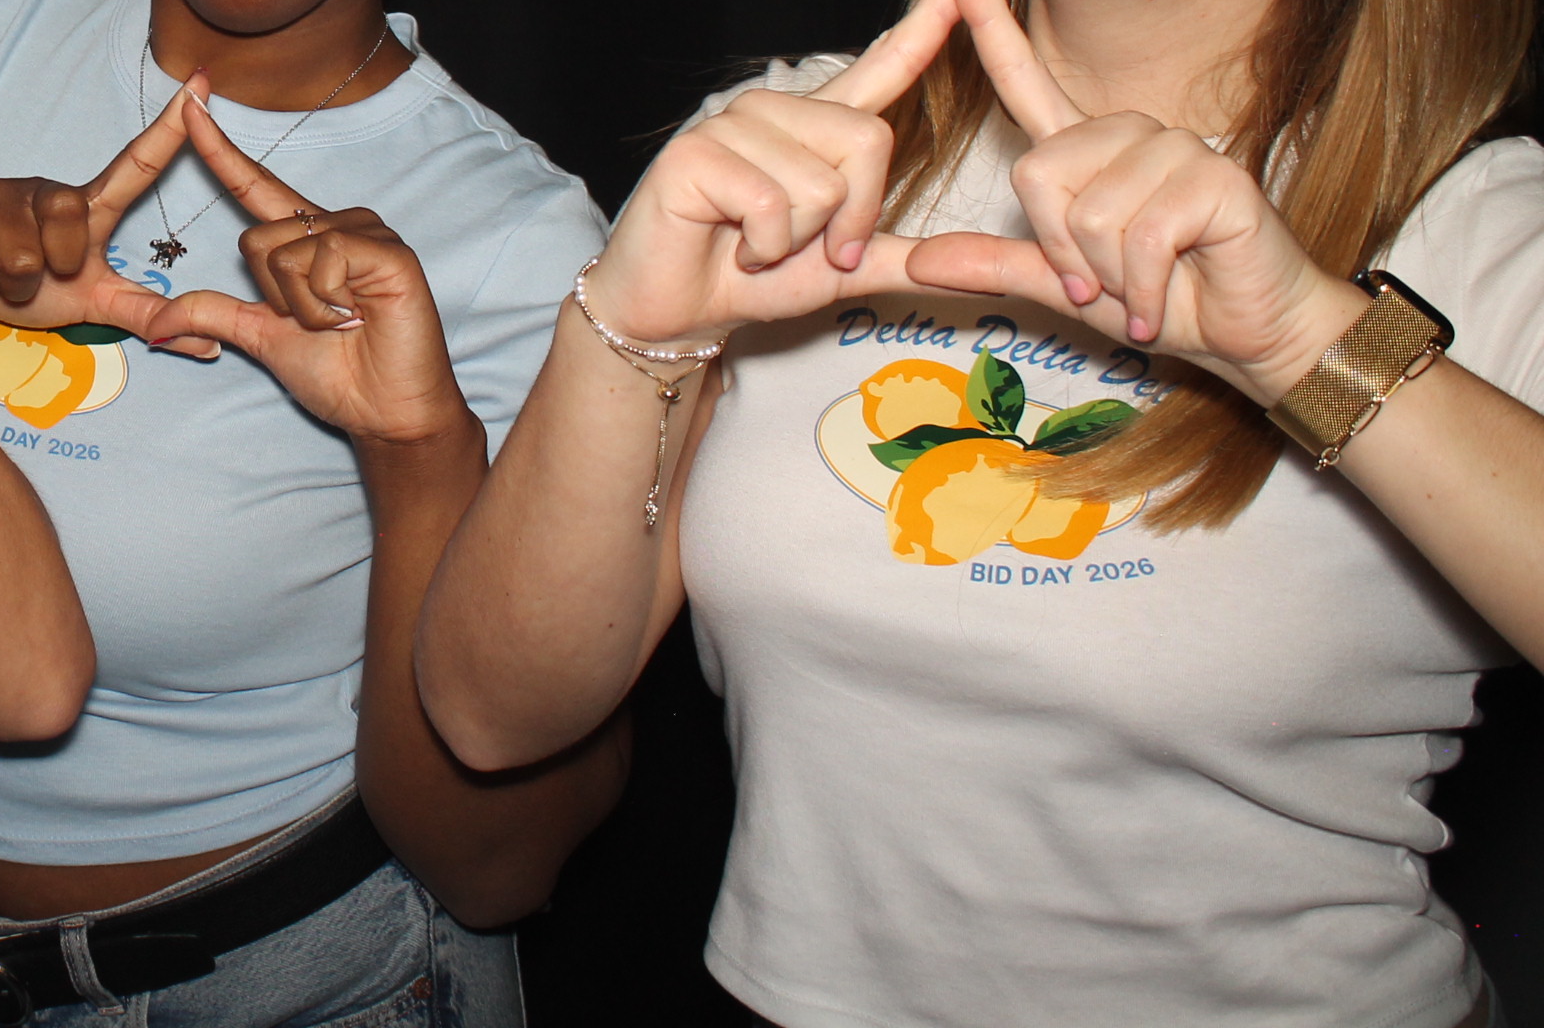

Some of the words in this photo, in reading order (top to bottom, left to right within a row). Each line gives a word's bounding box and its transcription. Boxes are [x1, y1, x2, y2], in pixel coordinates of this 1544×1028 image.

[836, 307, 959, 349] Delta
[971, 314, 1089, 375] Delta
[0, 426, 42, 450] DAY
[47, 437, 101, 461] 2026
[969, 562, 1013, 585] BID
[1021, 565, 1073, 586] DAY
[1085, 557, 1155, 582] 2026
